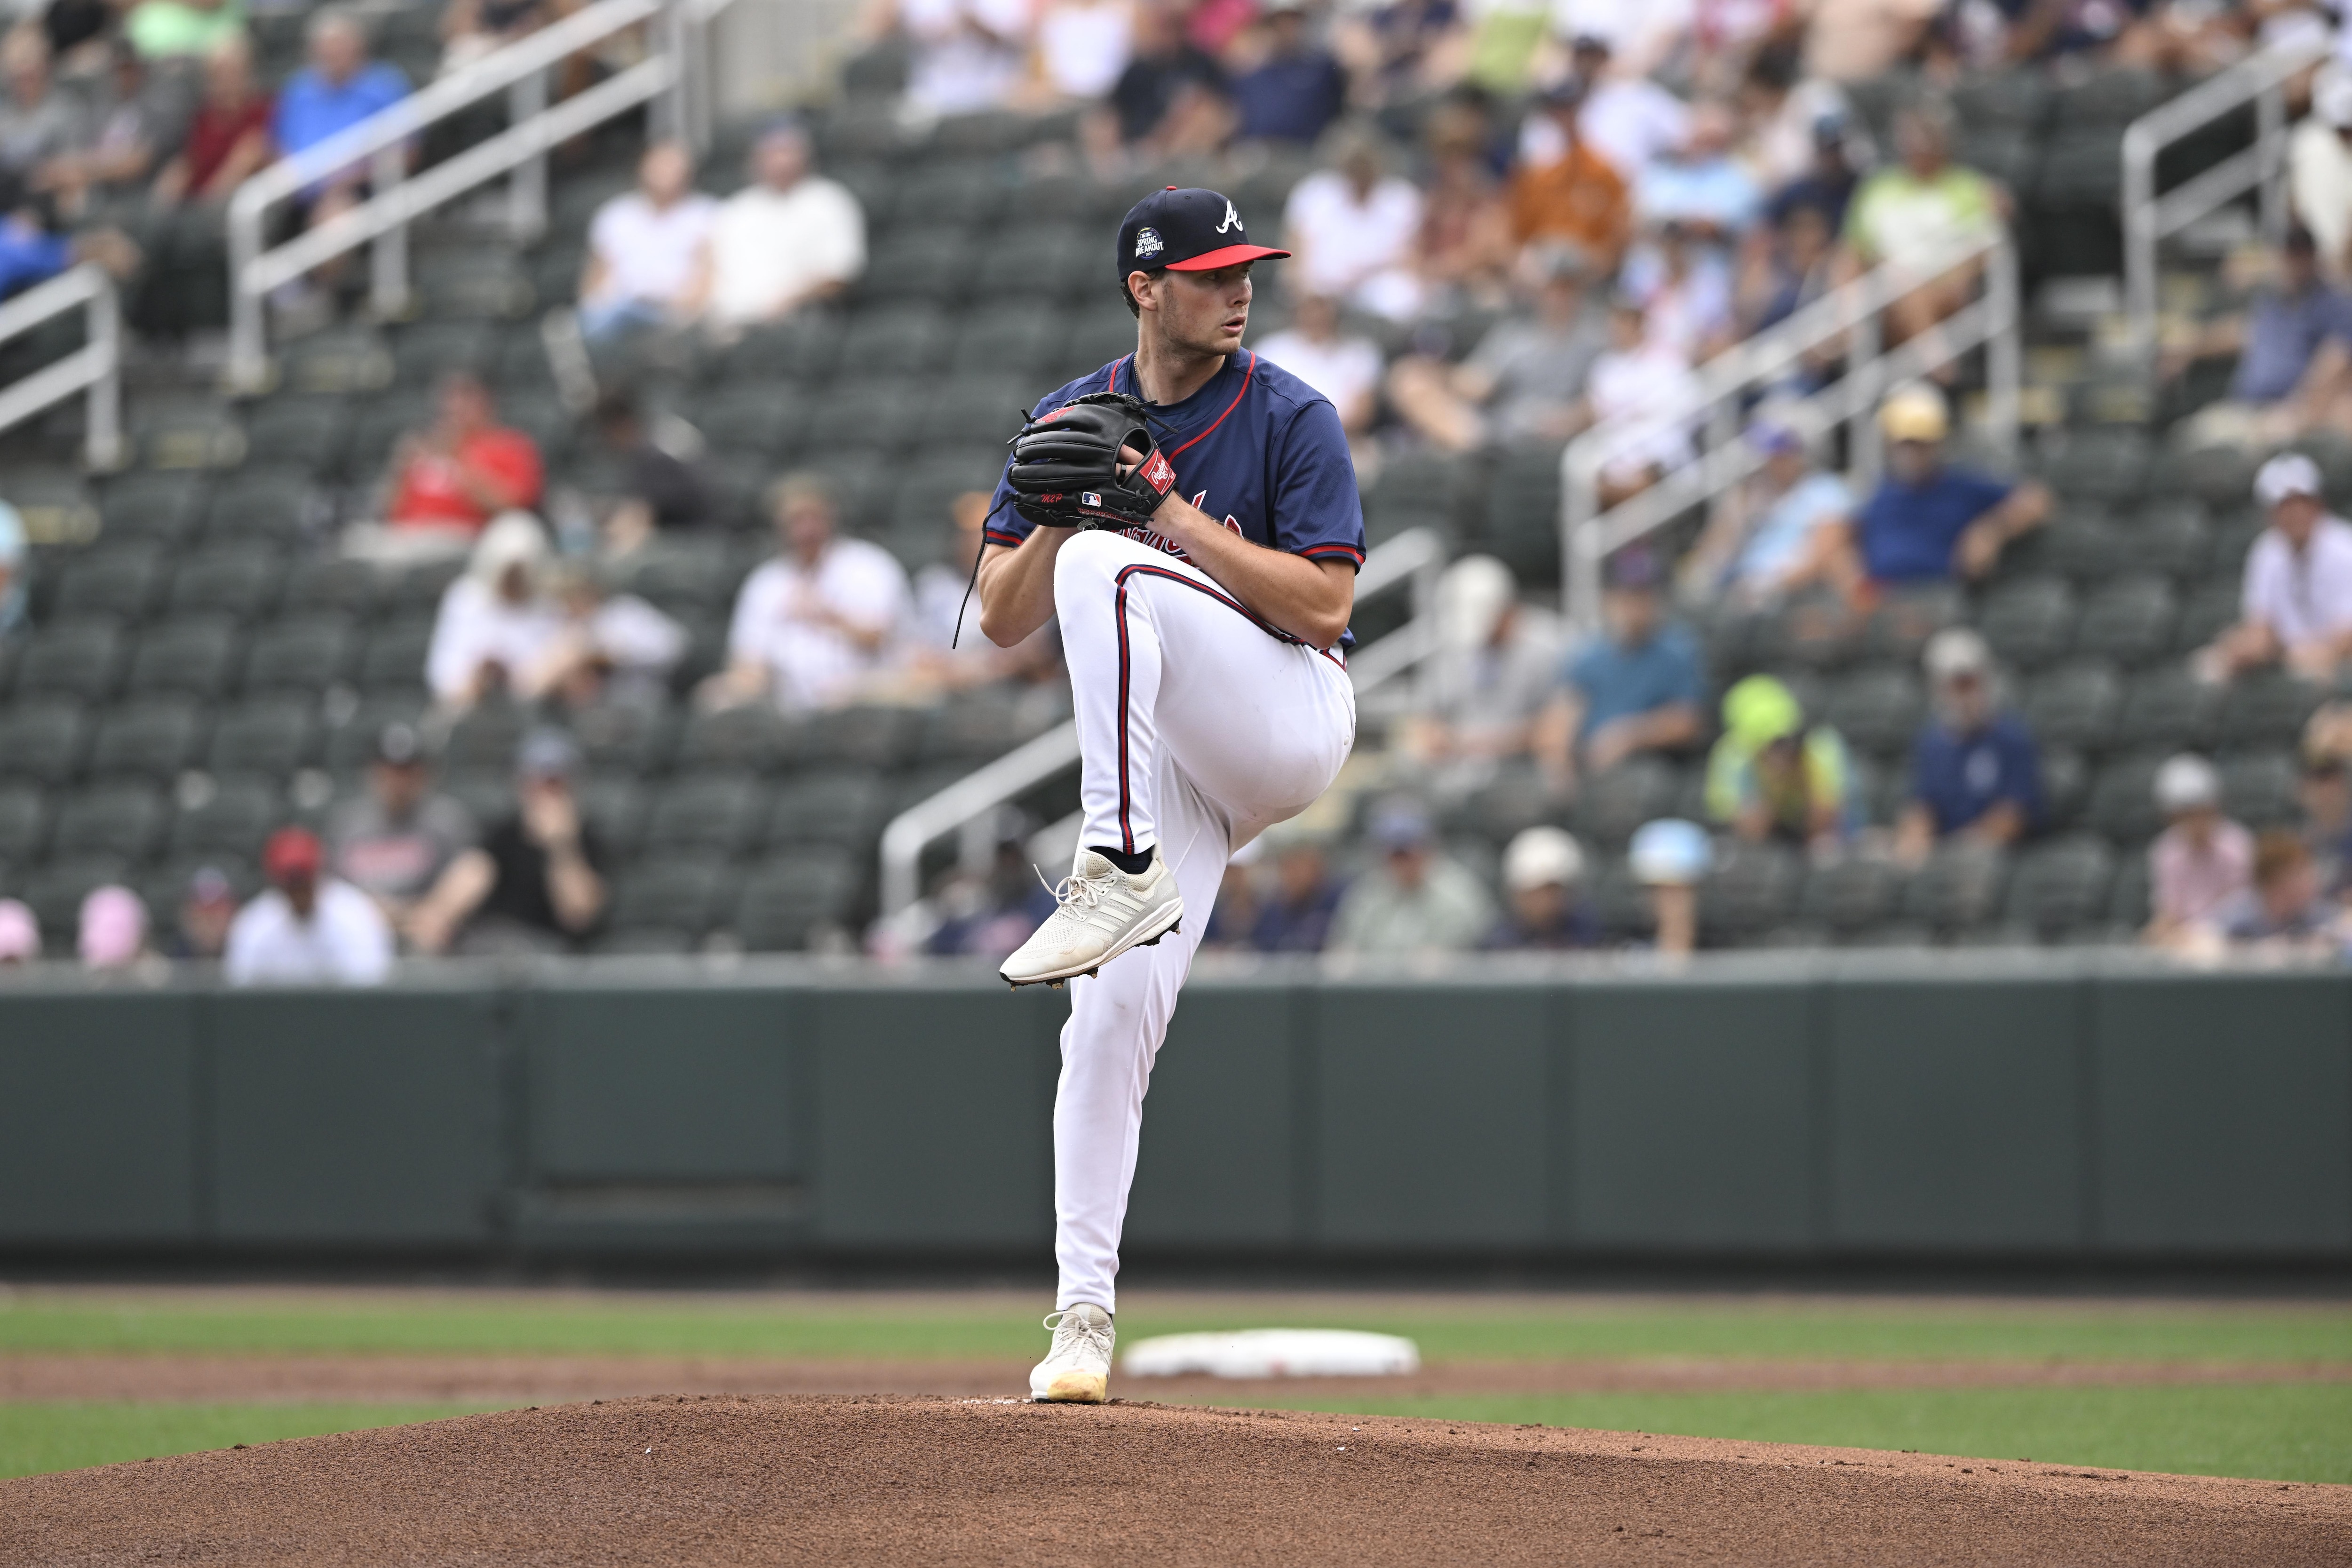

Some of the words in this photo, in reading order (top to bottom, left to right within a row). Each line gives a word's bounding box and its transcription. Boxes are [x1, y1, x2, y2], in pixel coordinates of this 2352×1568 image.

[1216, 200, 1243, 233] A
[1137, 236, 1157, 247] SPRING
[1136, 242, 1163, 257] BREAKOUT
